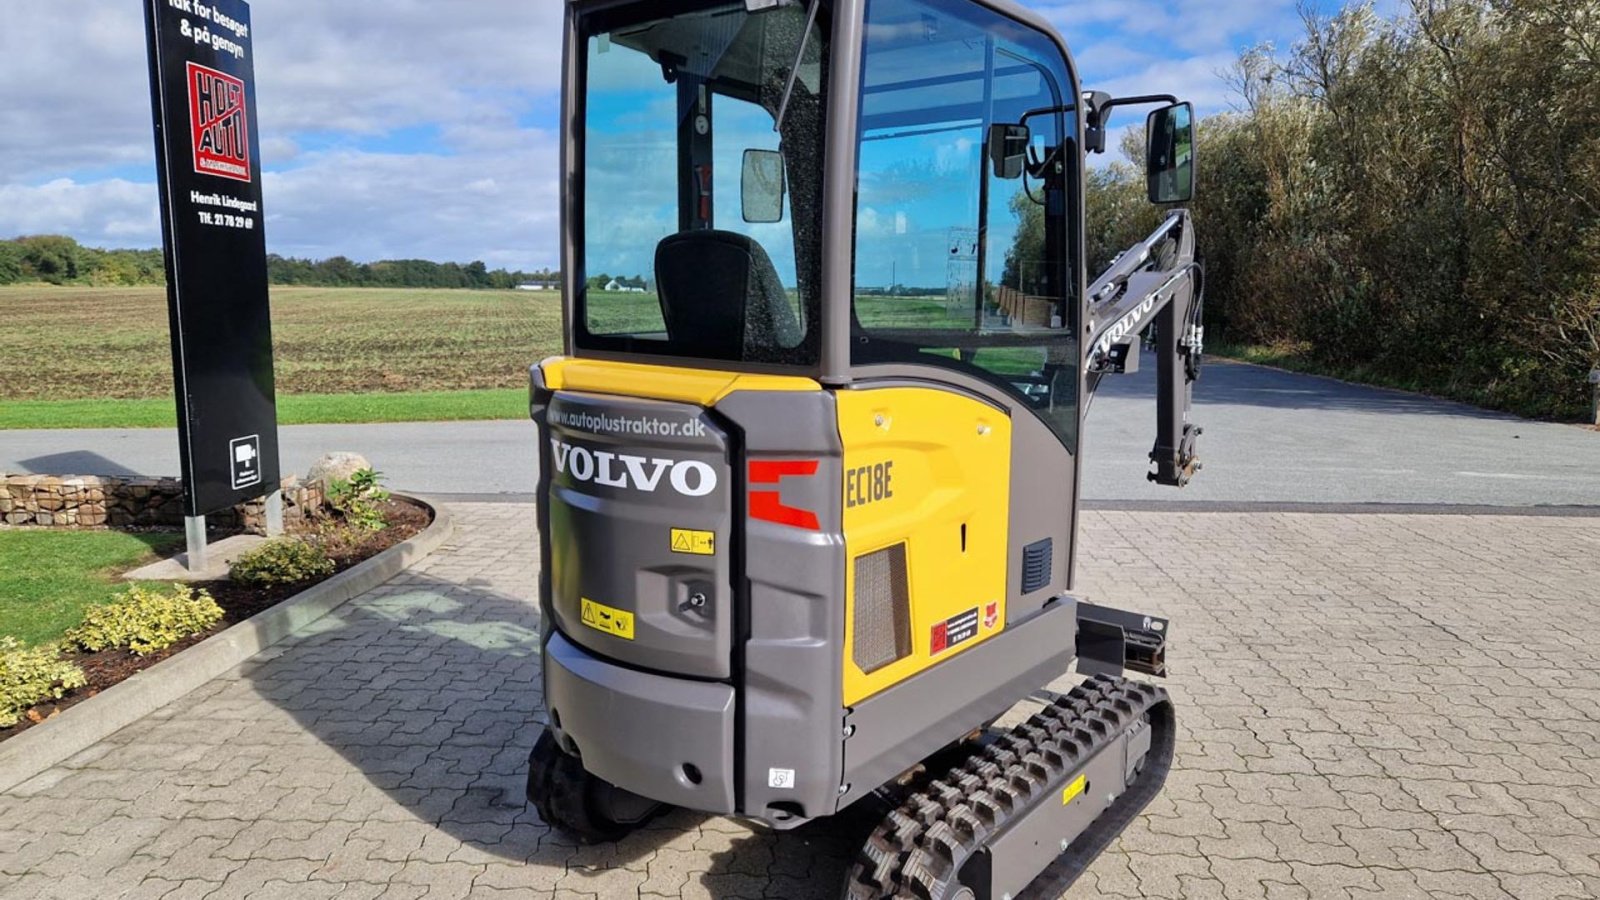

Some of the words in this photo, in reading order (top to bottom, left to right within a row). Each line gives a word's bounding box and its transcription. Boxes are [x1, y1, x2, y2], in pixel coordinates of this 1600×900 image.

[193, 0, 211, 19] for
[180, 18, 192, 37] &
[194, 26, 210, 44] på
[212, 34, 244, 59] gensyn
[195, 71, 241, 127] HOLT
[198, 107, 245, 161] AUTO
[191, 190, 221, 206] Henrik
[198, 211, 213, 225] Tlf.
[214, 213, 224, 226] 21
[1100, 297, 1154, 353] VOLVO
[550, 438, 717, 497] VOLVO
[847, 460, 893, 508] EC18E
